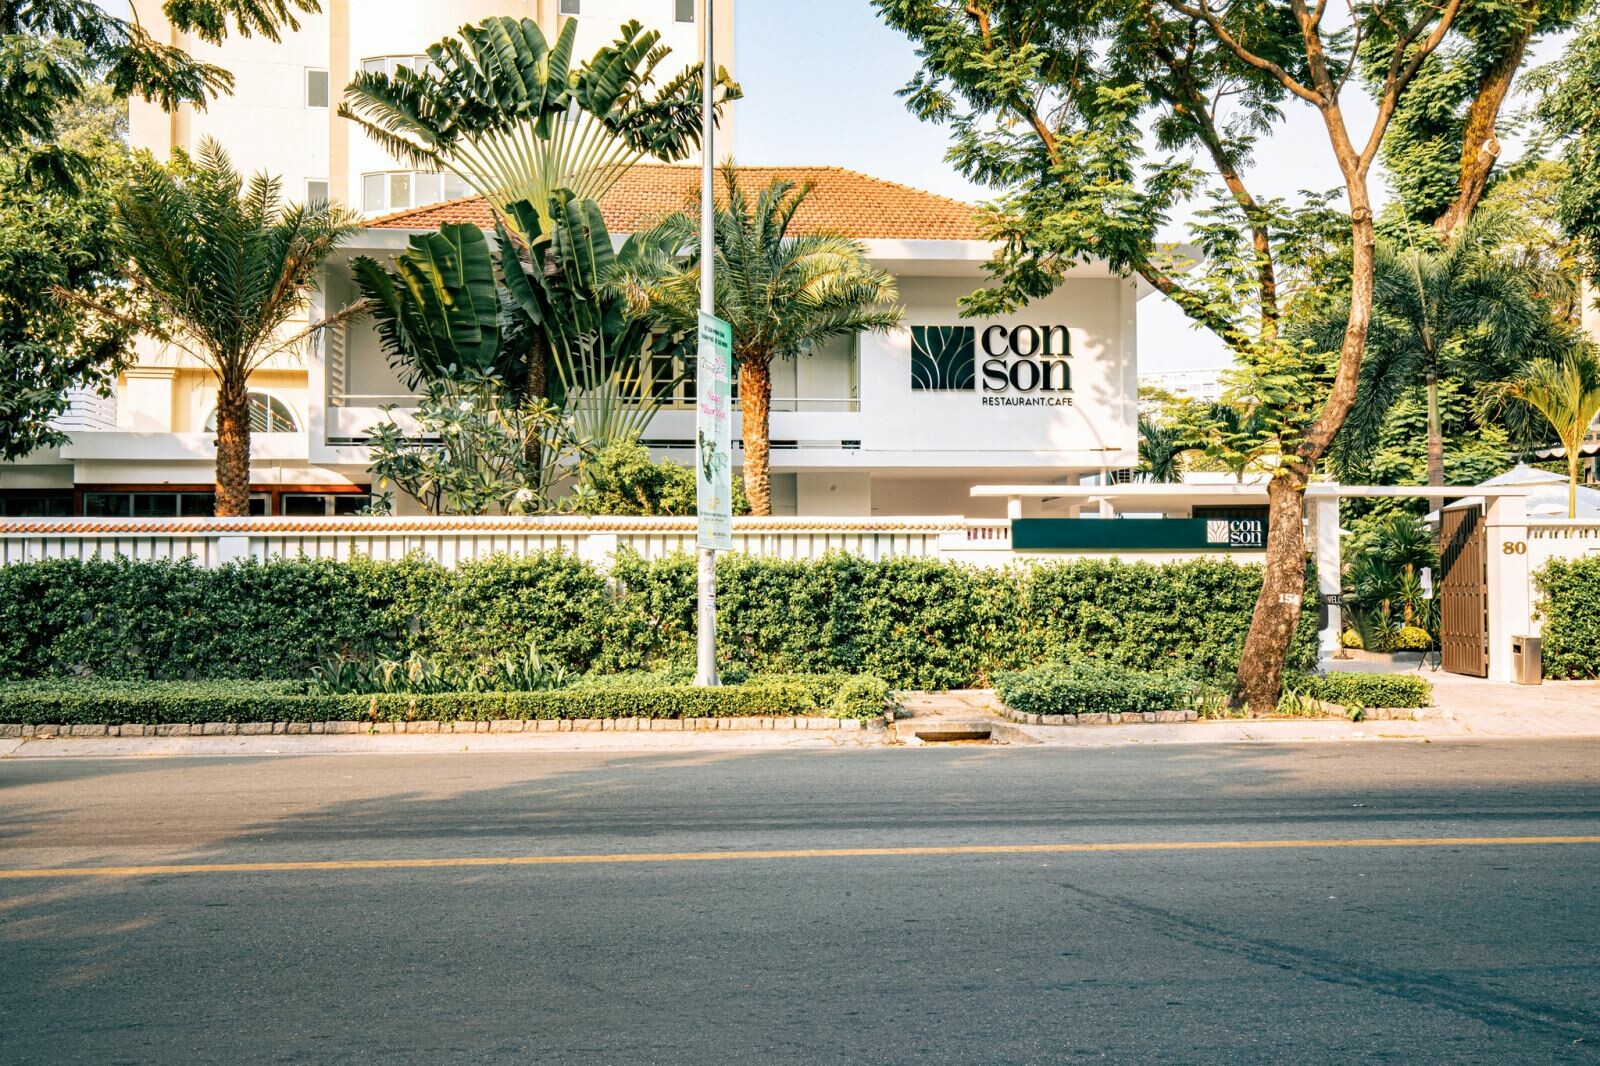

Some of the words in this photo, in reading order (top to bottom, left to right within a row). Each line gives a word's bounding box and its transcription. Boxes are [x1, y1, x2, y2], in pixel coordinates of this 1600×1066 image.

[981, 324, 1072, 358] con
[982, 359, 1073, 391] son
[982, 397, 1073, 406] RESTAURANT.CAFE
[1230, 520, 1261, 531] con
[1230, 532, 1261, 543] son
[1503, 541, 1526, 555] 80
